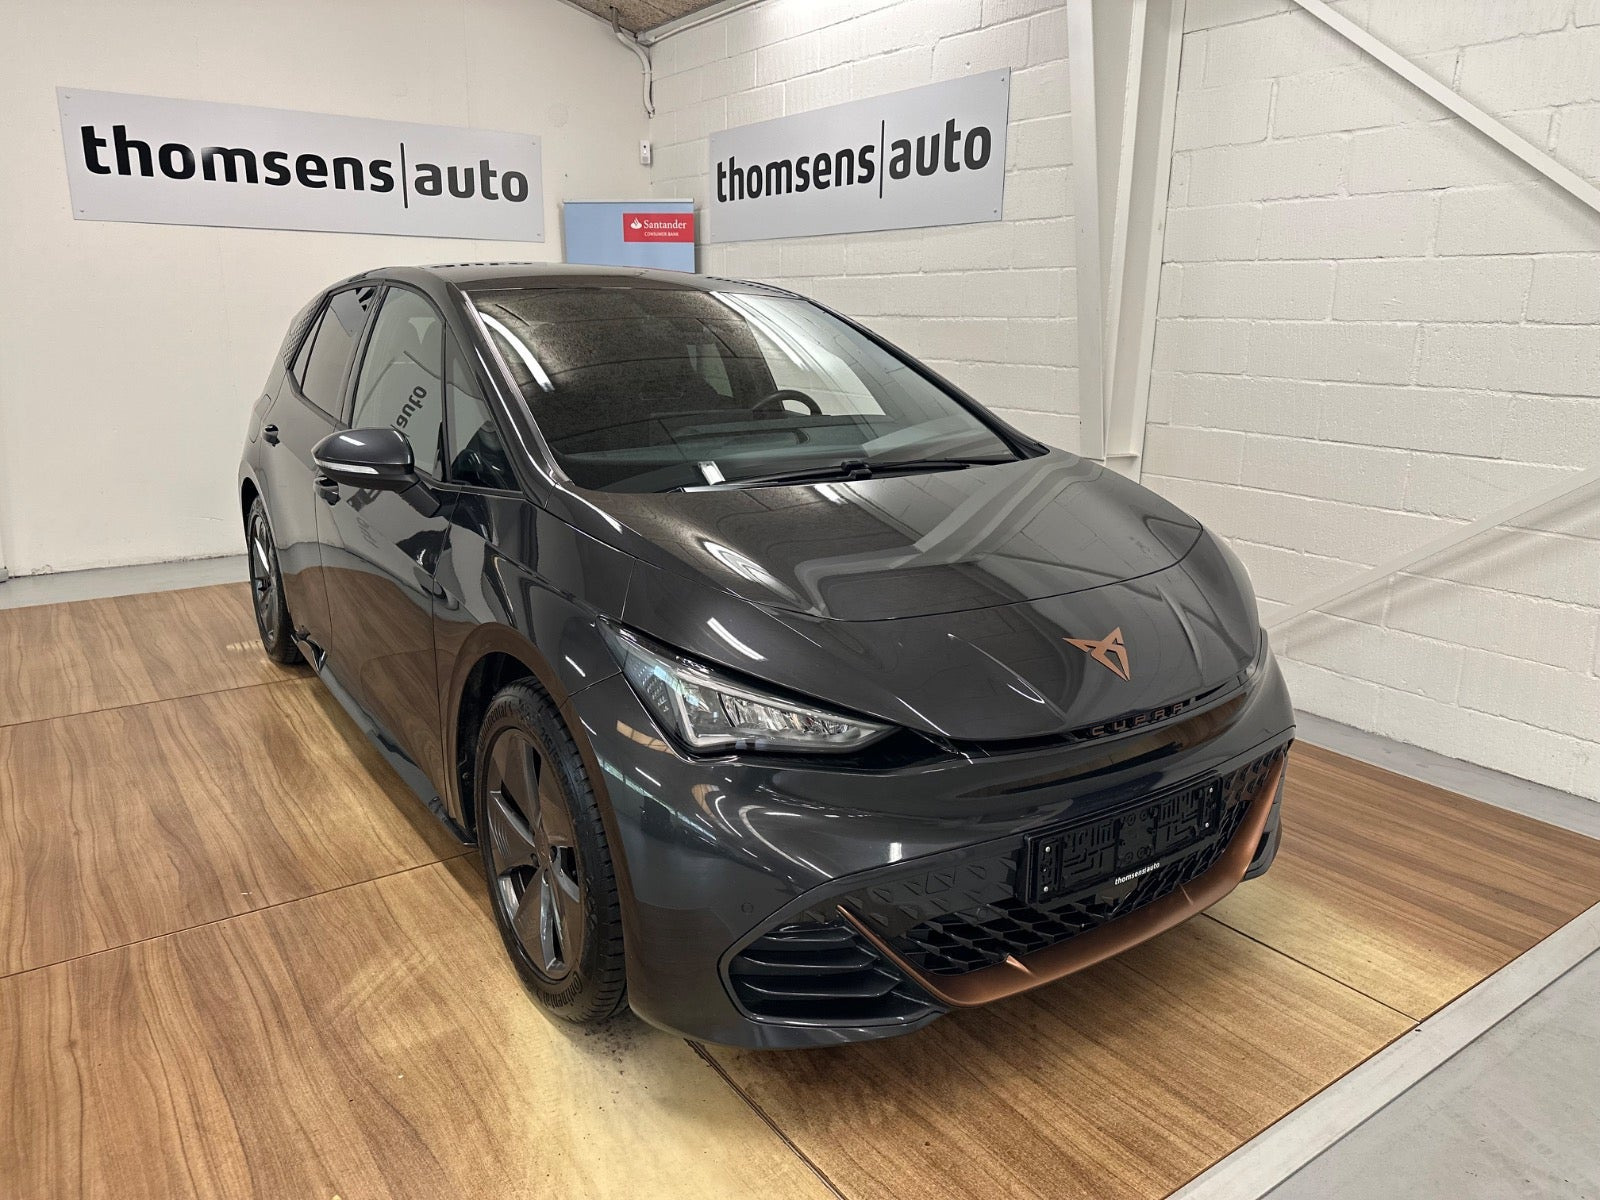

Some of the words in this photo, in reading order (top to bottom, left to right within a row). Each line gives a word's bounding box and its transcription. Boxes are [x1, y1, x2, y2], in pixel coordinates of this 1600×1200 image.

[81, 125, 394, 192] thomsens
[415, 160, 528, 202] auto
[718, 145, 874, 202] thomsens
[890, 119, 991, 179] auto
[643, 218, 687, 229] Santander
[1092, 702, 1184, 736] CUPRA
